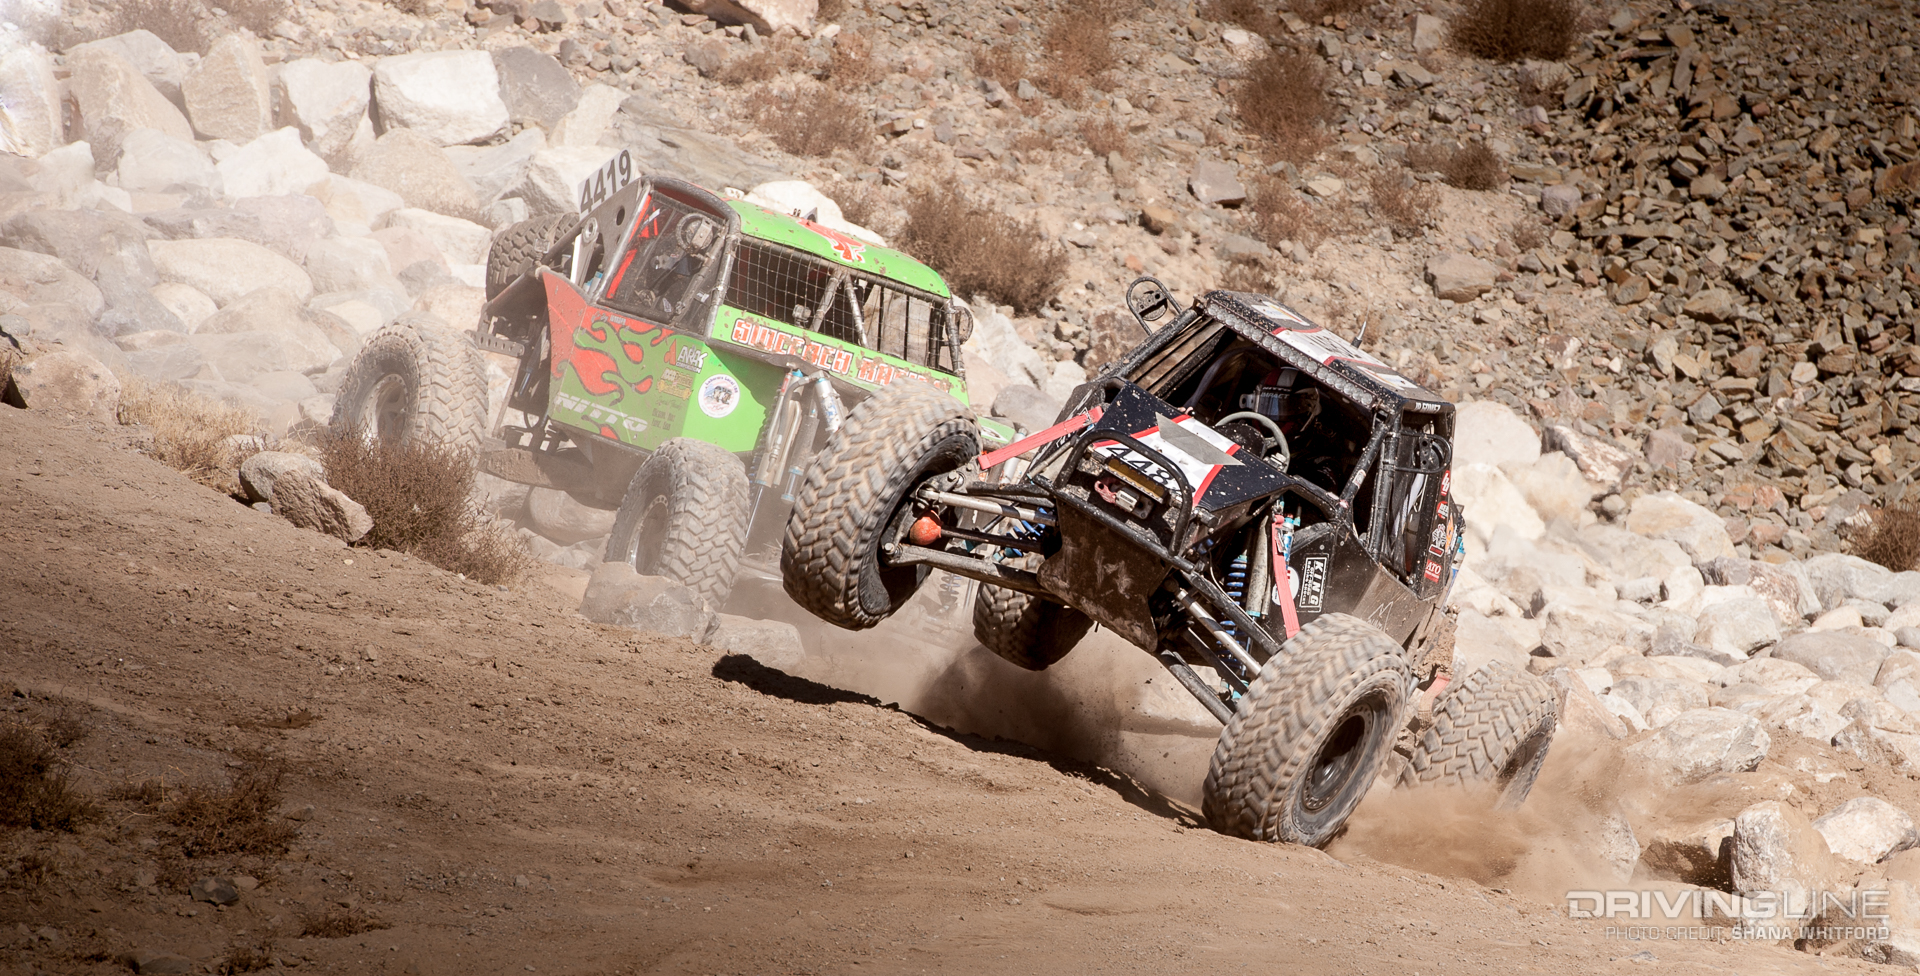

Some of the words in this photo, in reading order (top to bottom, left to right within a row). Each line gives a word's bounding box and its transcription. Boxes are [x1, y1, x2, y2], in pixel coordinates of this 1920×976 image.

[580, 149, 631, 214] 4419
[554, 392, 648, 432] NITTO
[1106, 447, 1196, 495] 448
[1311, 560, 1323, 605] KING
